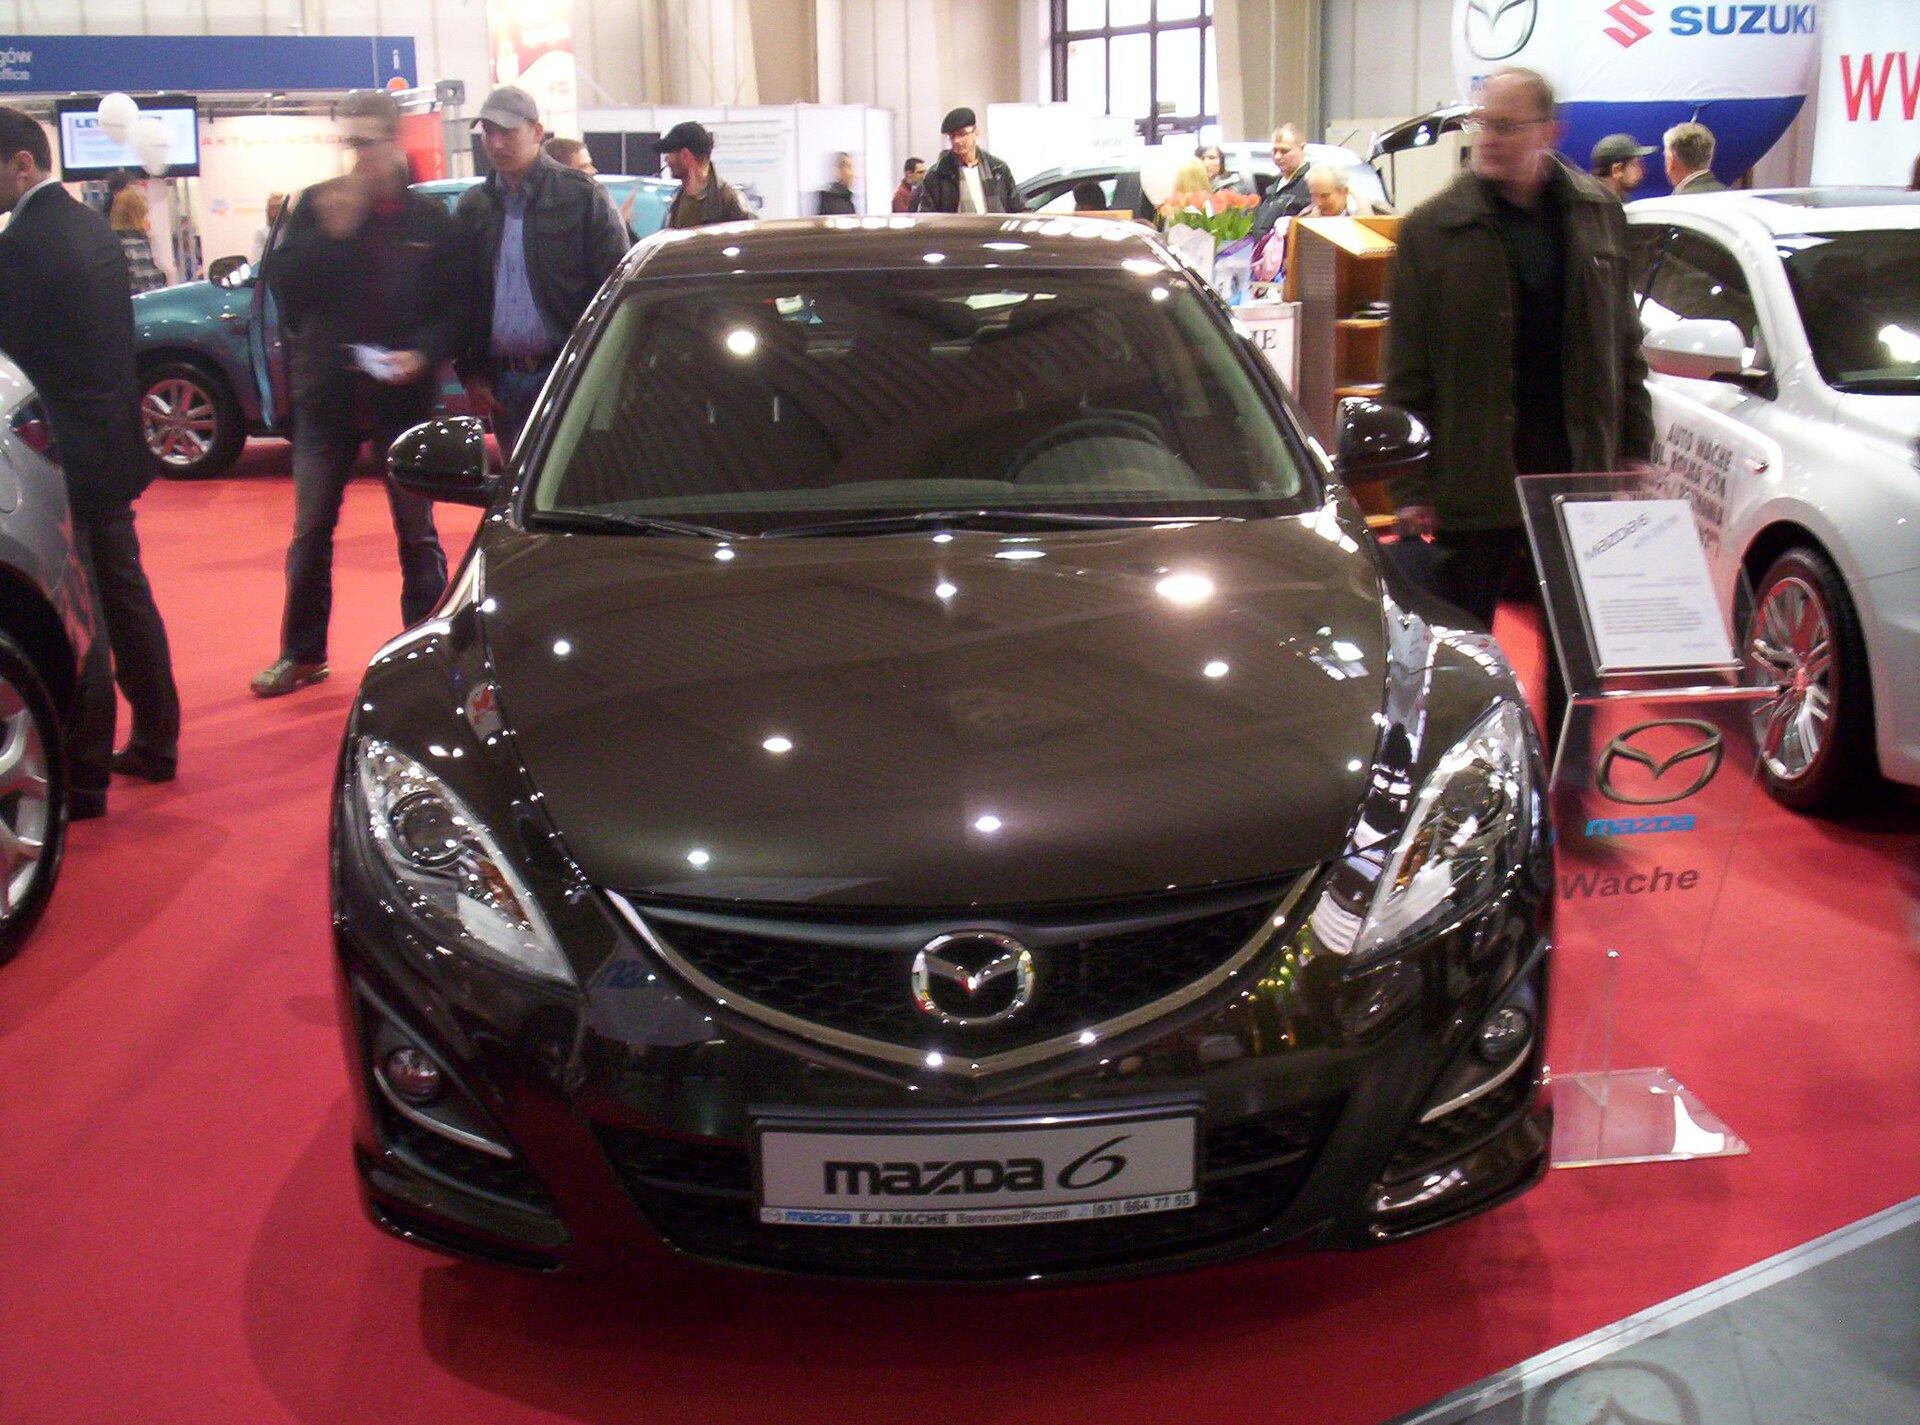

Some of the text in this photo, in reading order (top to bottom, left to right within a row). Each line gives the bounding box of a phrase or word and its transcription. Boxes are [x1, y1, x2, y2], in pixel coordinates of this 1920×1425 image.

[1669, 4, 1815, 36] SUZUKI
[1561, 866, 1699, 900] Wache
[823, 1135, 1133, 1195] mazda 6
